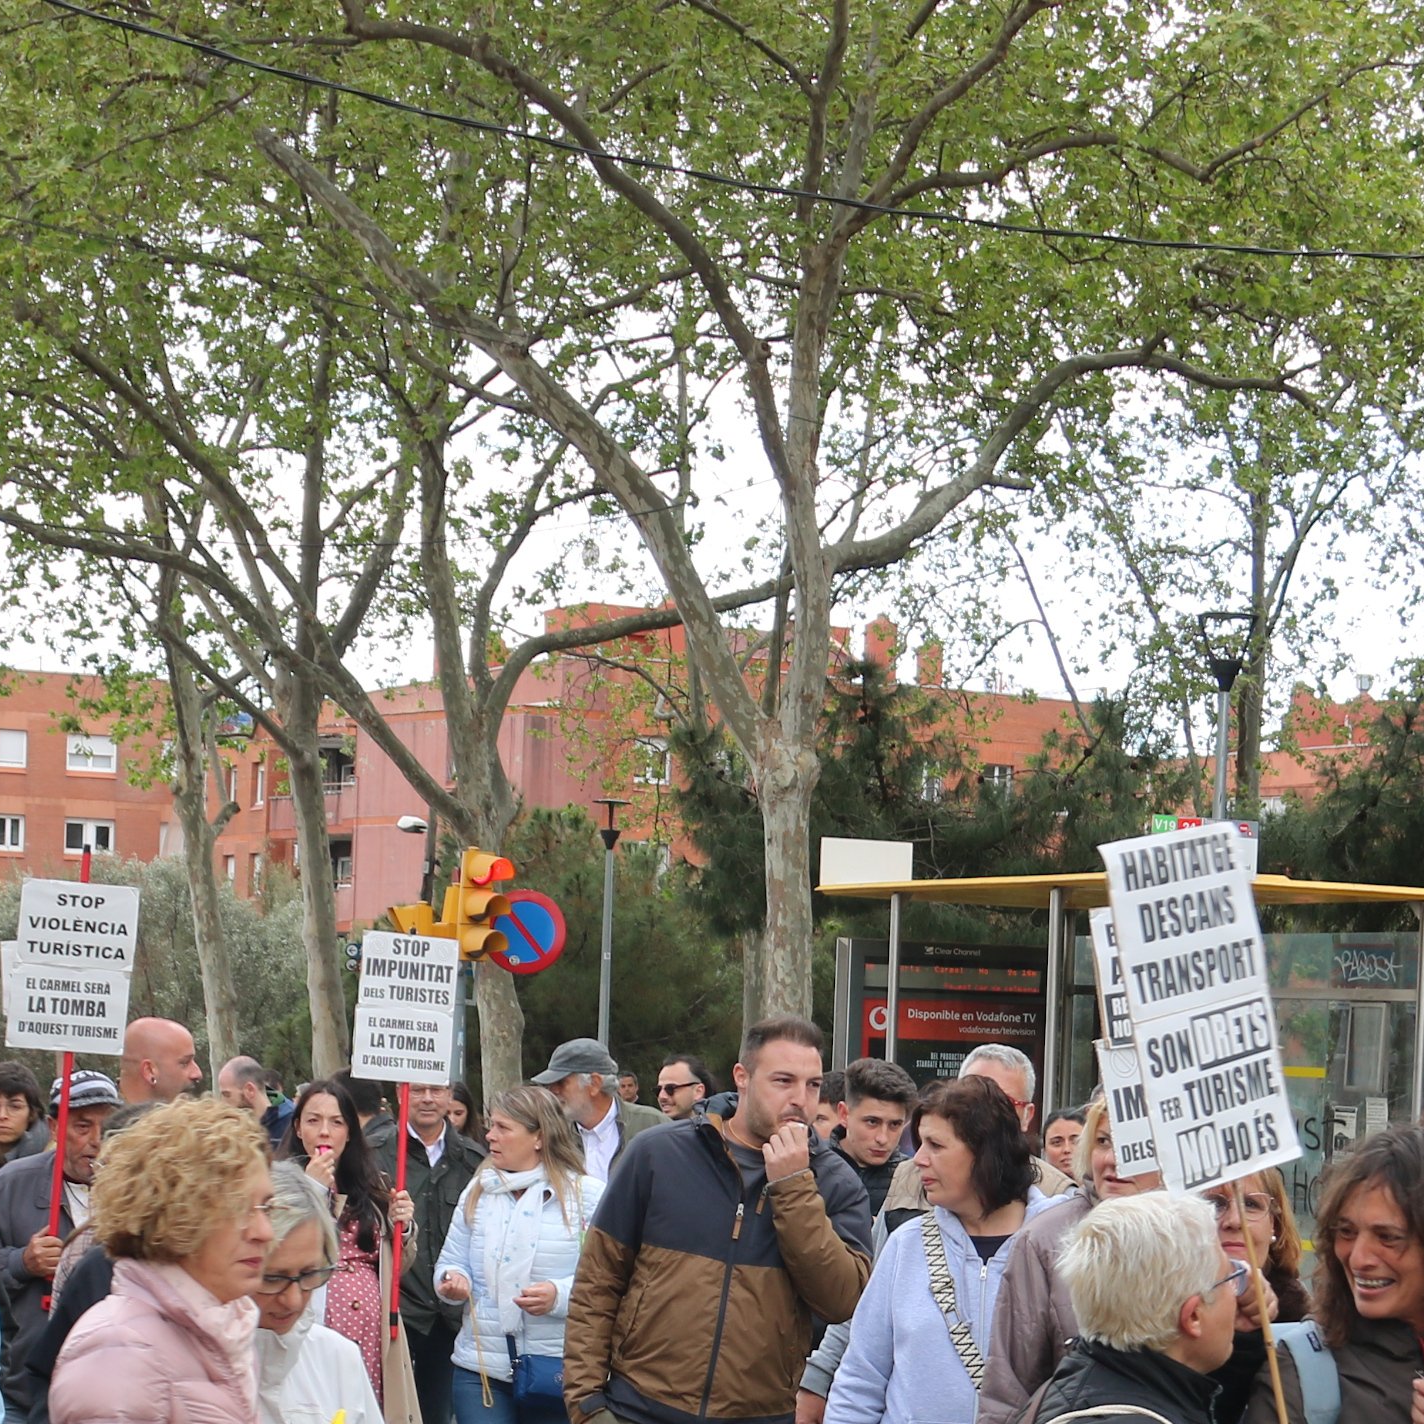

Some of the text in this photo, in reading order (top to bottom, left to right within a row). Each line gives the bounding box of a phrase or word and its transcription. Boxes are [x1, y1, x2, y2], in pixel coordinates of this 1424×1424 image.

[1155, 818, 1176, 831] V19
[1119, 832, 1237, 892] HABITATGE
[57, 893, 106, 910] STOP
[1138, 885, 1236, 943] DESCANS
[29, 916, 128, 936] VIOLÈNCIA
[27, 940, 126, 960] TURÍSTICA
[392, 938, 430, 957] STOP
[935, 947, 980, 956] Clear Channel
[365, 957, 453, 984] IMPUNITAT
[1131, 937, 1258, 1004] TRANSPORT
[26, 977, 111, 995] EL CARMEL SERÀ
[364, 985, 450, 1006] DELS TURISTES
[28, 996, 106, 1018] LA TOMBA
[908, 1008, 1036, 1023] Disponible en Vodafone TV
[18, 1020, 119, 1039] D'AQUEST TURISME
[368, 1017, 439, 1033] EL CARMEL SERÀ
[959, 1026, 1036, 1036] vodafone.es/television
[370, 1033, 436, 1053] LA TOMBA
[1147, 1000, 1270, 1078] SON DRETS
[362, 1054, 446, 1072] D'AQUEST TURISME
[1159, 1096, 1184, 1123] FER
[1121, 1139, 1155, 1164] DELS
[1178, 1125, 1222, 1185] NO
[1220, 1121, 1251, 1166] HO
[1253, 1109, 1280, 1155] ÉS
